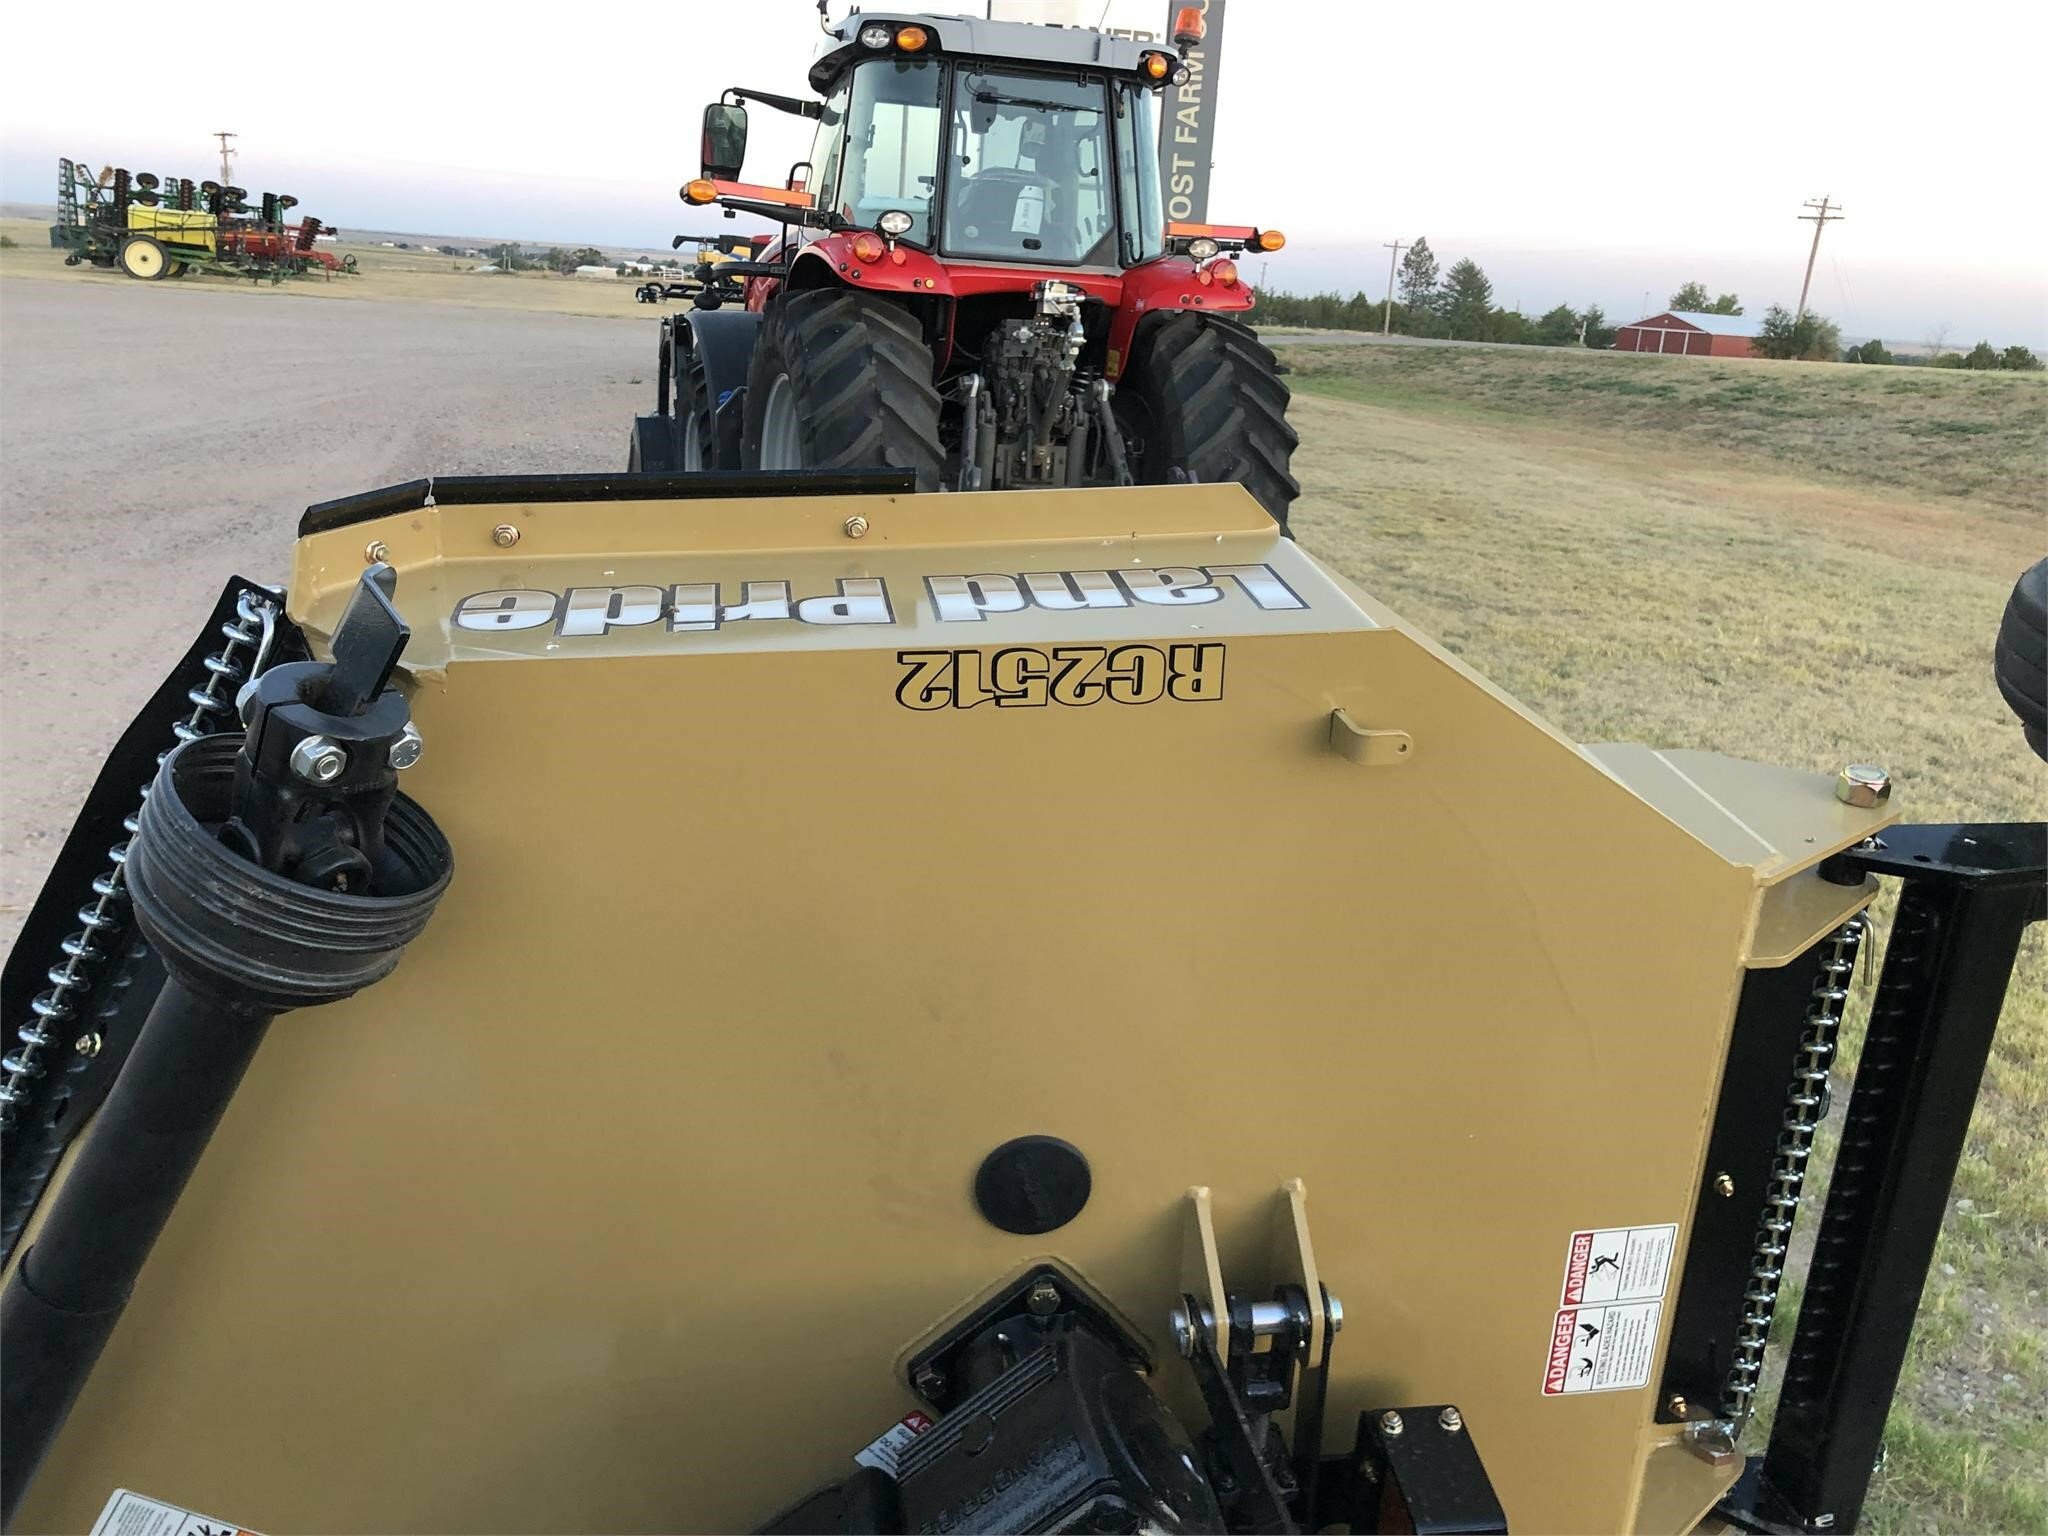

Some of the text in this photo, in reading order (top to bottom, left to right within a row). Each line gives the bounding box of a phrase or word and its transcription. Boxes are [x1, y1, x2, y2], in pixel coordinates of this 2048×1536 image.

[1175, 51, 1204, 144] FARM
[1167, 153, 1195, 223] OST
[452, 563, 1311, 637] Land Pride
[896, 643, 1226, 711] RC2512
[1568, 1235, 1591, 1286] DANGER
[1550, 1312, 1574, 1378] DANGER
[1605, 1311, 1616, 1333] HAZARD
